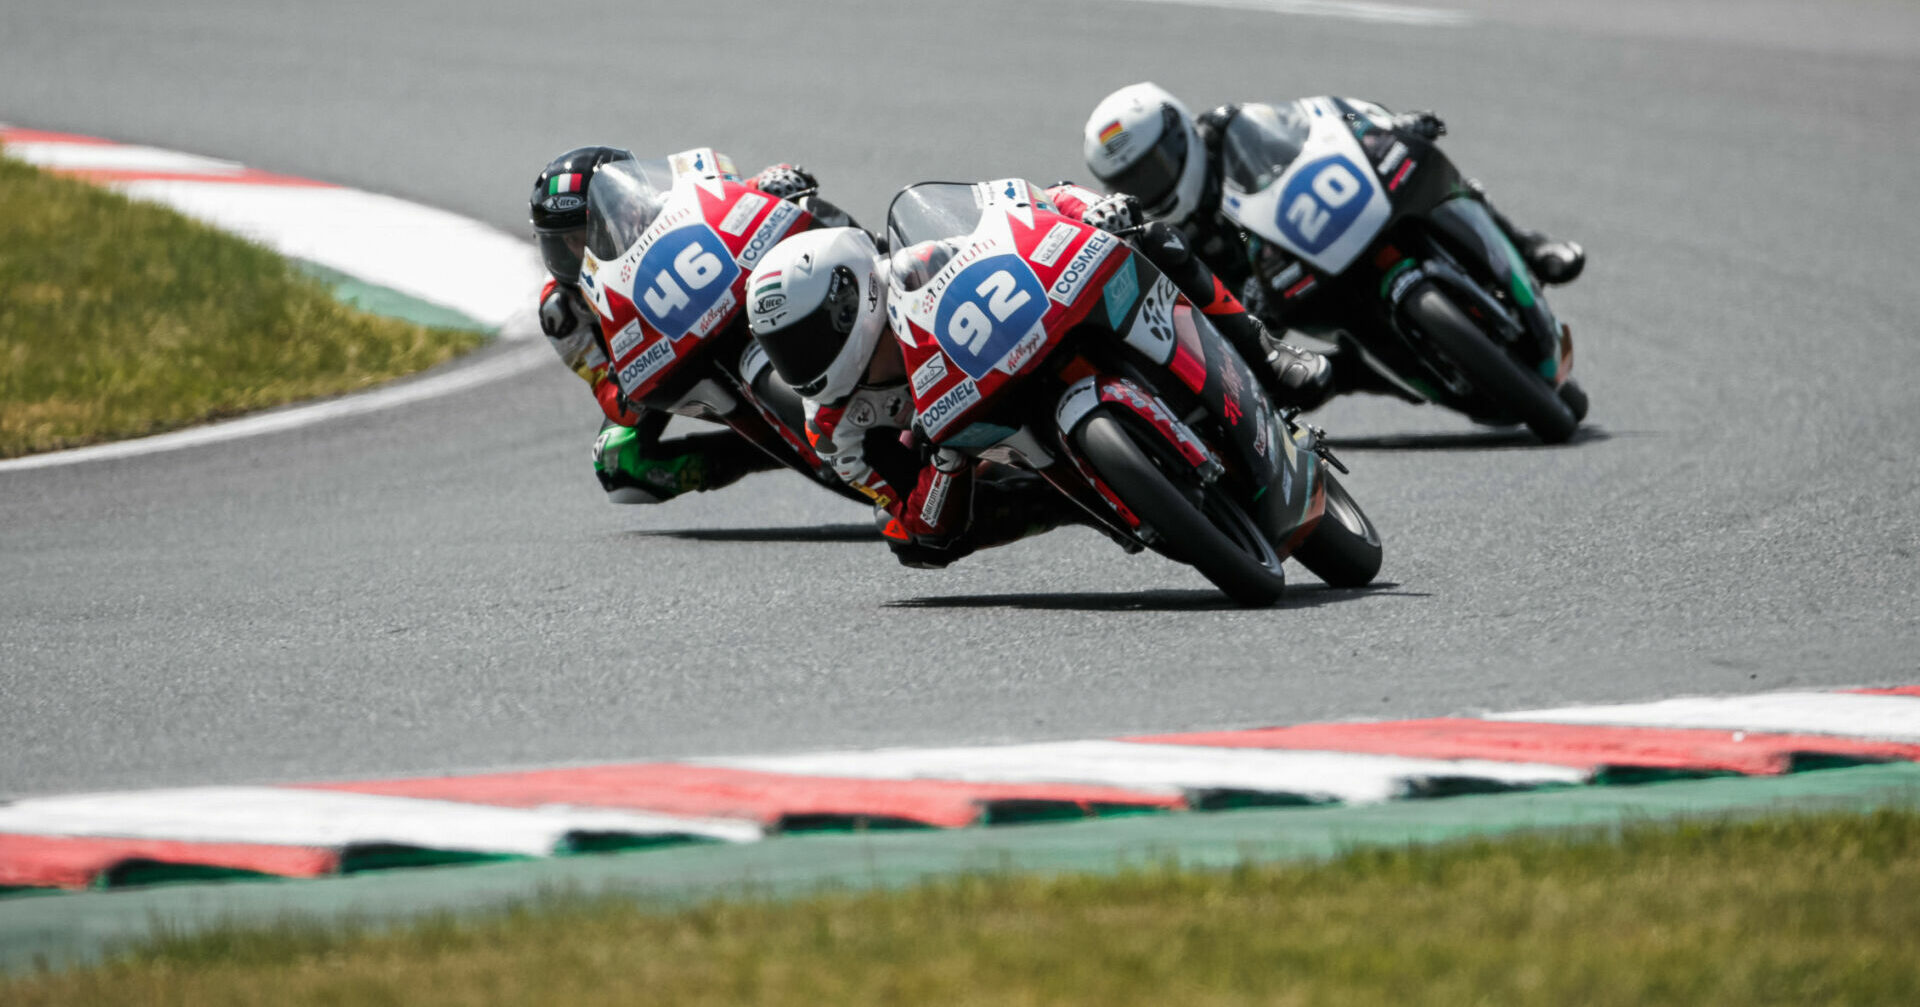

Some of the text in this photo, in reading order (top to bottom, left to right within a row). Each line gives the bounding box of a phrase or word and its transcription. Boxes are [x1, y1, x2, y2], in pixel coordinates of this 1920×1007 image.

[743, 203, 793, 261] COSMEL
[1286, 163, 1360, 243] 20
[643, 241, 723, 319] 46
[1055, 233, 1110, 294] COSMEL
[948, 270, 1032, 357] 92
[622, 342, 670, 383] COSMEL
[923, 381, 975, 428] COSMEL
